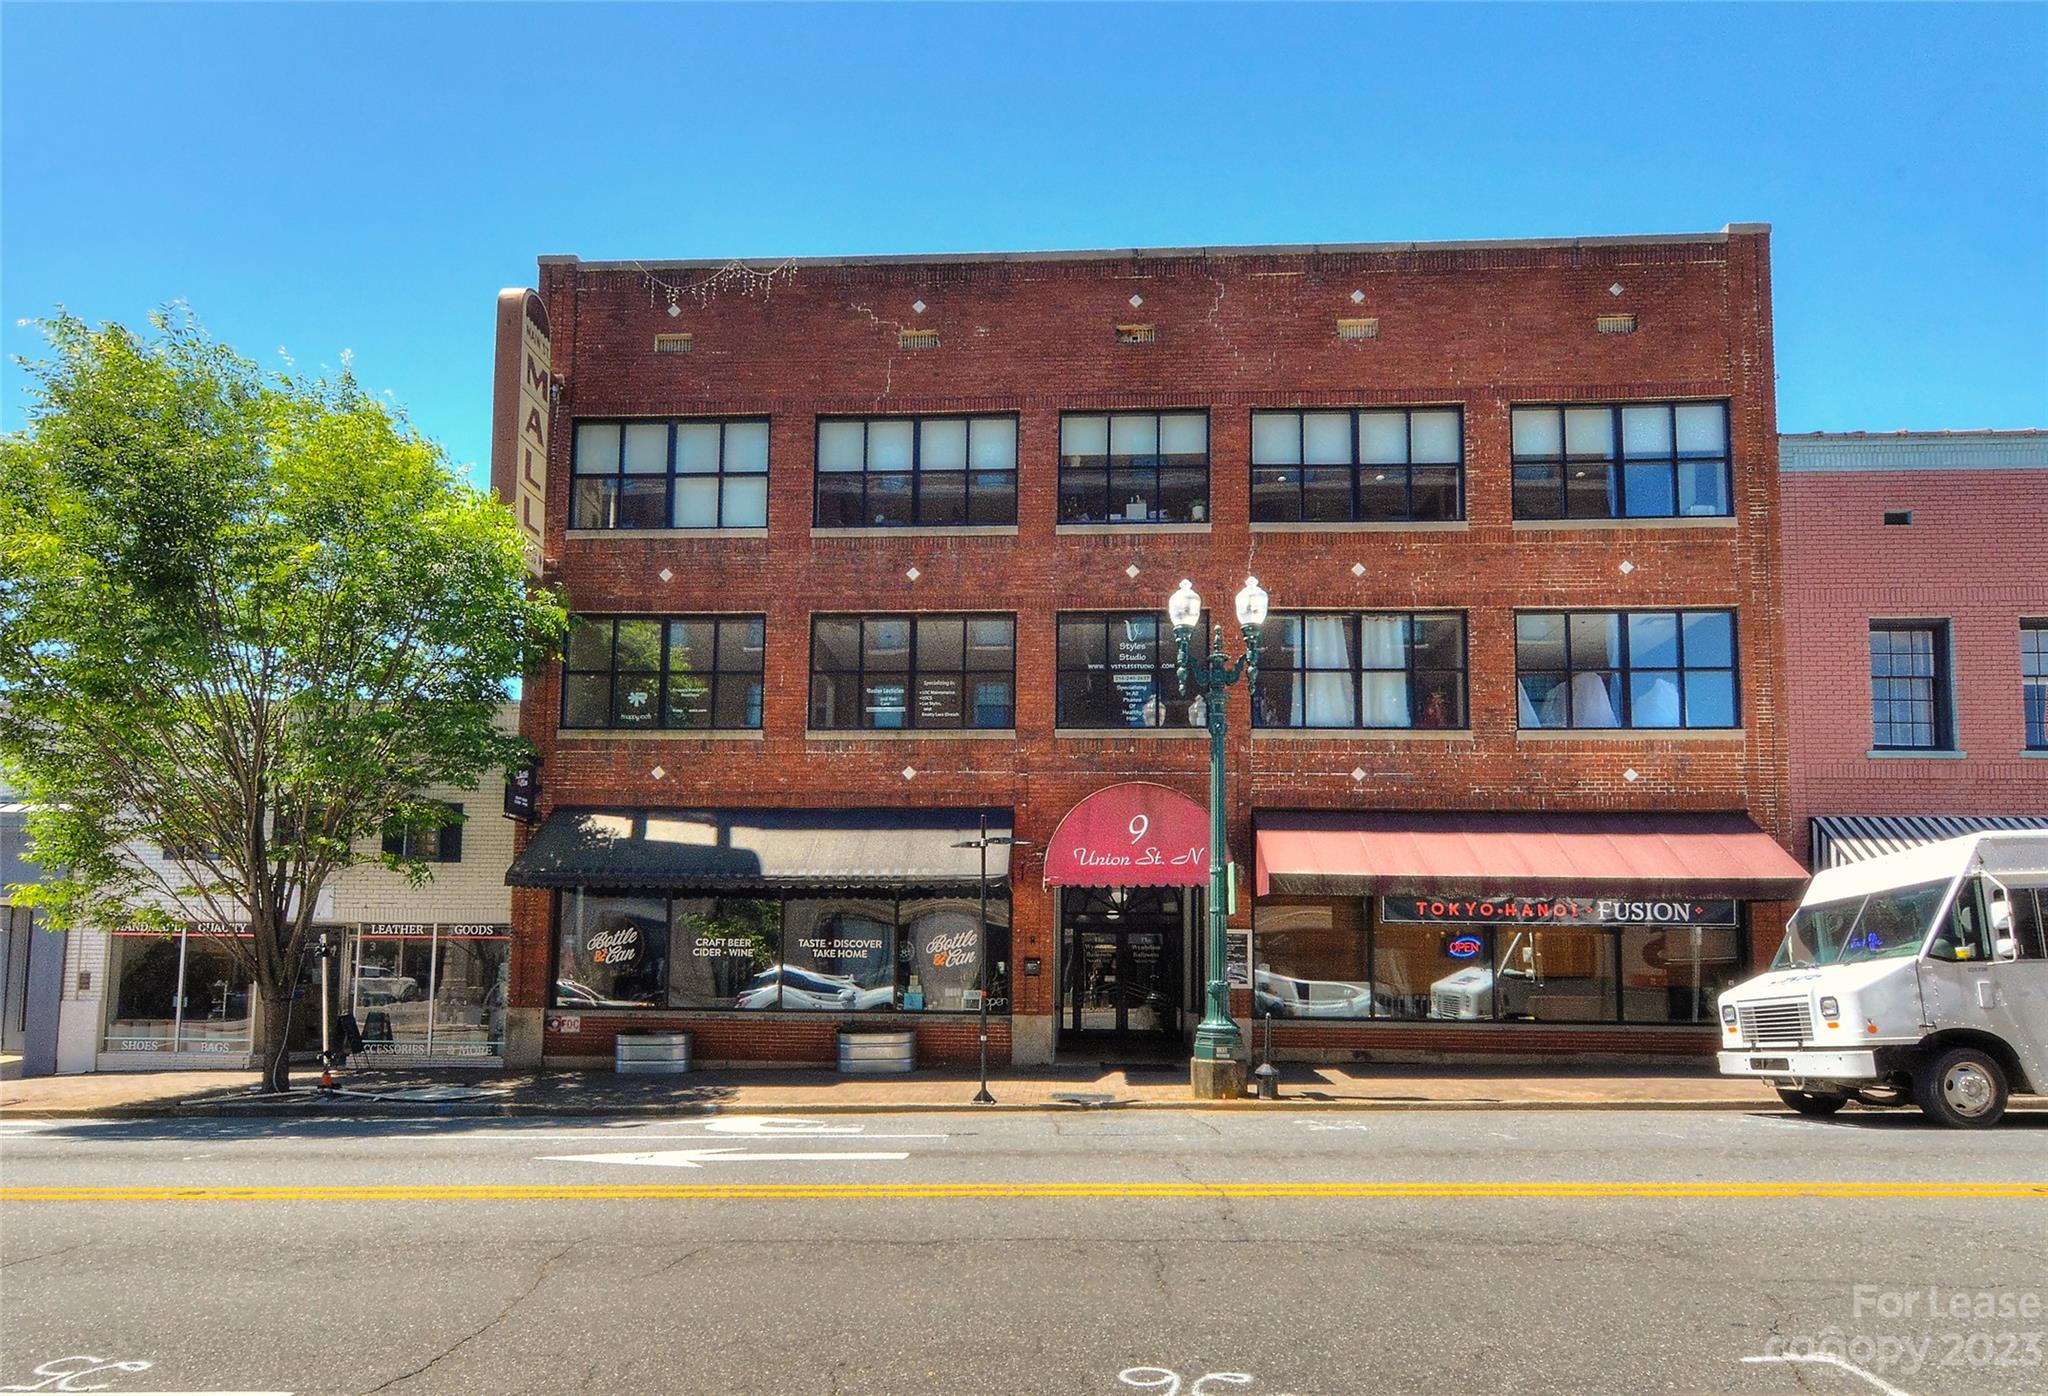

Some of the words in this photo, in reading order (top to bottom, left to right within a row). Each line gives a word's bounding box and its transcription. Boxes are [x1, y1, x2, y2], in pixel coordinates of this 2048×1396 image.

[523, 352, 549, 537] MALL
[1120, 642, 1146, 652] Styles
[1120, 653, 1146, 661] Studio
[1128, 814, 1149, 845] 9
[1073, 848, 1131, 866] Union
[1135, 847, 1165, 866] St.
[1171, 847, 1205, 866] N
[1416, 901, 1493, 916] TOKYO
[1505, 902, 1578, 917] HANOI
[1597, 901, 1691, 922] FUSION
[371, 924, 424, 935] LEATHER
[455, 925, 494, 935] GOODS
[587, 927, 638, 951] Bottle
[695, 938, 726, 947] CRAFT
[727, 938, 752, 947] BEER
[798, 938, 827, 948] TASTE
[833, 939, 882, 949] DISCOVER
[926, 929, 977, 953] Bottle
[692, 948, 722, 957] CIDER
[729, 948, 754, 957] WINE
[1449, 941, 1480, 953] OPEN
[605, 946, 636, 965] Can
[812, 949, 836, 958] TAKE
[837, 949, 868, 958] HOME
[945, 949, 976, 968] Can
[121, 1040, 159, 1051] SHOES
[200, 1041, 230, 1052] BAGS
[363, 1044, 425, 1055] CCESSORIES
[458, 1046, 493, 1055] MORE
